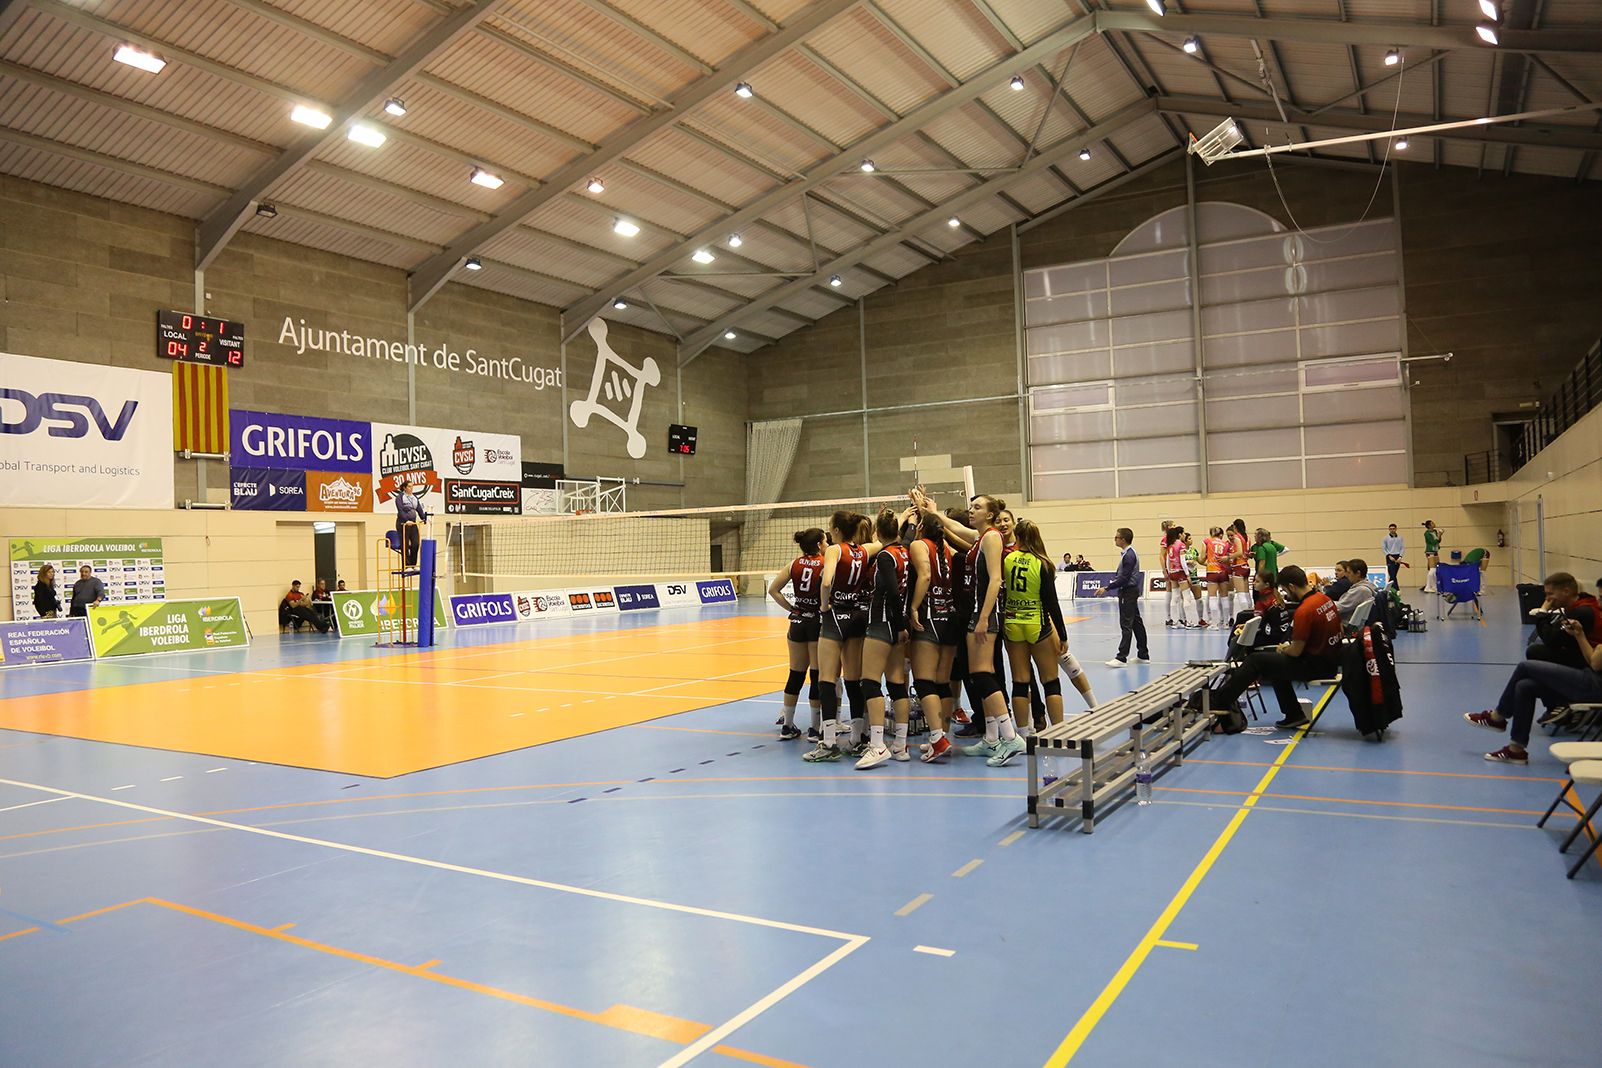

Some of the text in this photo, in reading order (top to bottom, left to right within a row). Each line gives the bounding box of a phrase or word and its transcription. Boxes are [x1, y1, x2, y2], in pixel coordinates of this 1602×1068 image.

[182, 315, 224, 334] 0 1
[164, 330, 187, 340] LOCAL
[219, 339, 240, 348] VISITANT
[168, 341, 241, 364] 04 2 12
[278, 316, 562, 390] Ajuntament de SantCugat
[0, 388, 138, 441] DSV
[242, 424, 363, 461] GRIFOLS
[400, 445, 427, 464] CVSC
[454, 449, 474, 463] CVSC
[24, 461, 75, 474] Transport
[79, 464, 97, 474] and
[100, 466, 140, 477] Logistics
[393, 472, 426, 488] 30 ANYS
[234, 487, 258, 496] BLAU
[280, 487, 303, 495] SOREA
[452, 484, 514, 501] SantCugatCreix
[63, 544, 104, 552] IBERDROLA
[1214, 544, 1224, 554] 13
[800, 567, 813, 592] 9
[848, 560, 862, 585] 17
[1011, 566, 1028, 592] 15
[667, 585, 686, 595] DSV
[701, 585, 731, 598] GRIFOLS
[456, 601, 512, 618] GRIFOLS
[167, 614, 187, 624] LIGA
[28, 628, 70, 637] FEDERACIÓN
[140, 624, 189, 636] IBERDROLA
[151, 635, 190, 646] VOLEIBOL
